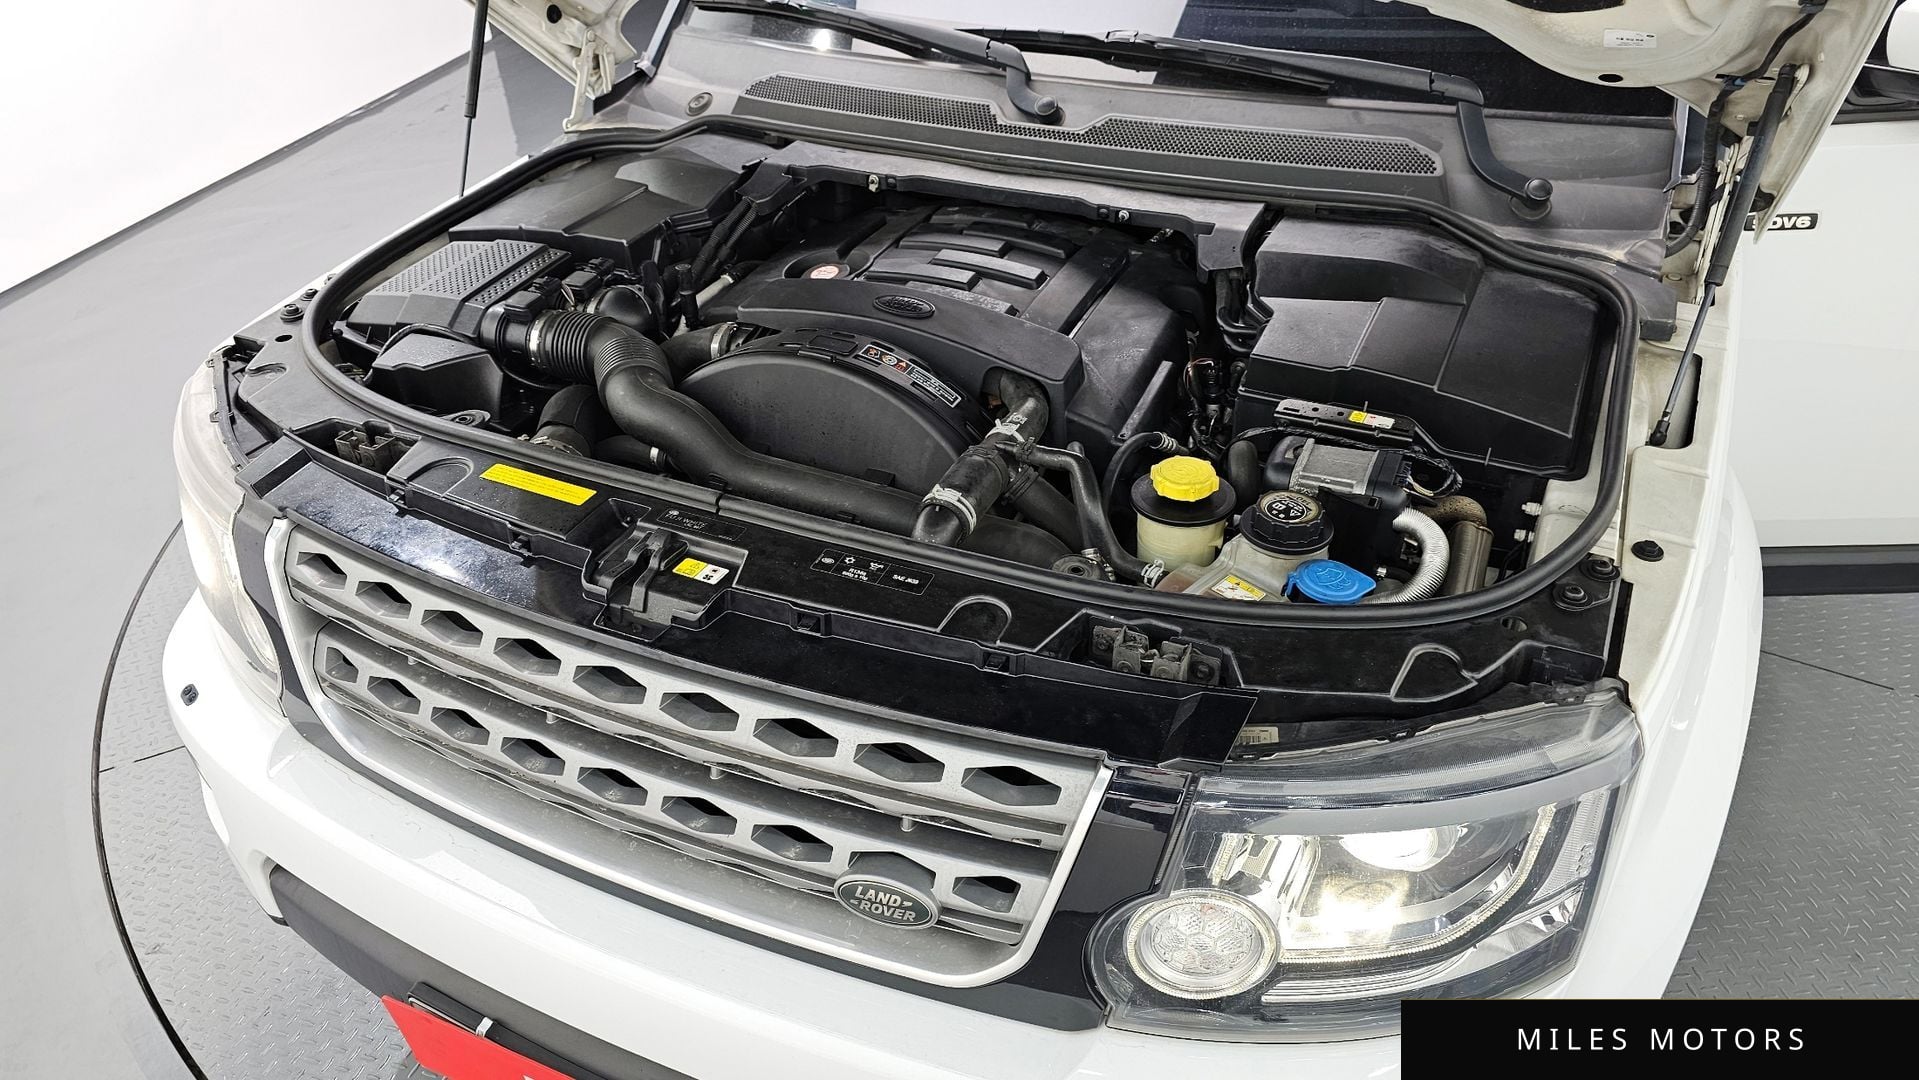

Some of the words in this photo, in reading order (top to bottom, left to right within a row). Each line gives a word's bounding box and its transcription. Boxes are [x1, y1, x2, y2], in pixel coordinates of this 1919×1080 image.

[1752, 215, 1812, 230] DV6
[855, 885, 902, 907] LAND
[859, 899, 916, 922] ROVER
